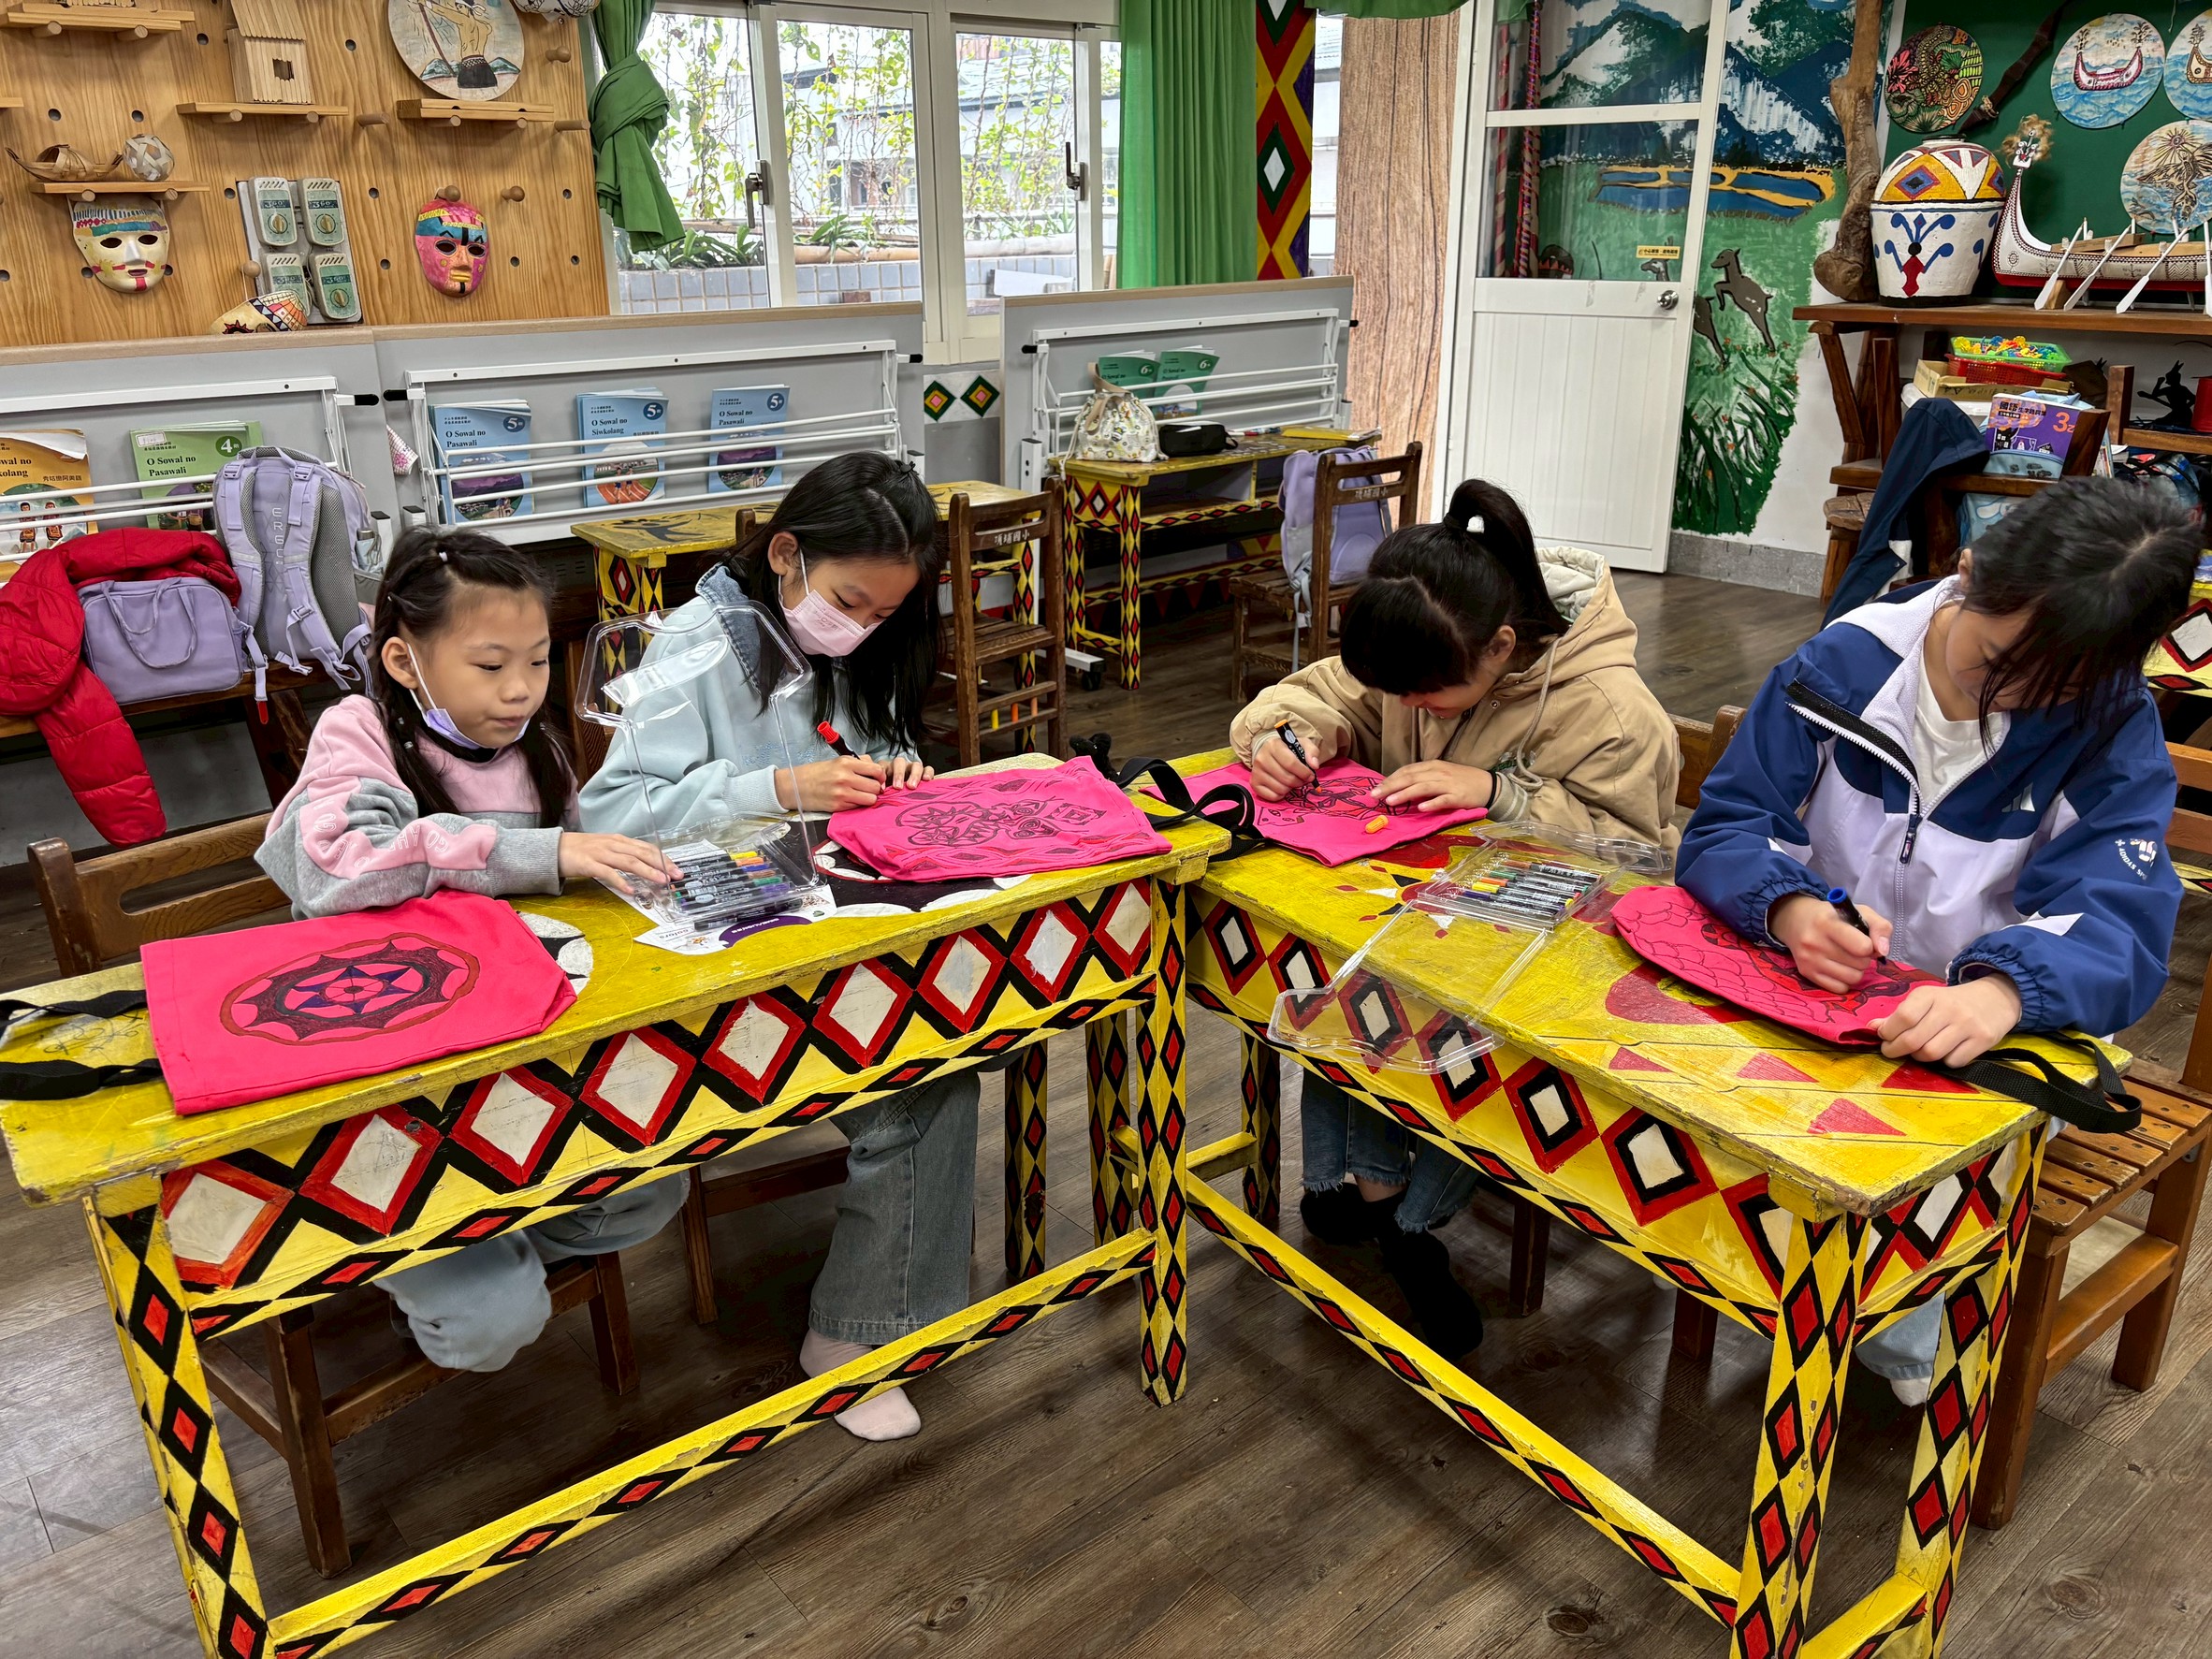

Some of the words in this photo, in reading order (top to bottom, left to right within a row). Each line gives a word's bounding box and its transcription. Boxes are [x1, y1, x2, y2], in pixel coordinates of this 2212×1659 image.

[599, 417, 618, 427] Sowal
[446, 439, 477, 448] Pasawali
[0, 457, 17, 465] wal
[146, 458, 154, 466] O
[157, 456, 183, 465] Sowal
[149, 466, 187, 477] Pasawali
[2118, 848, 2137, 870] ADIDAS
